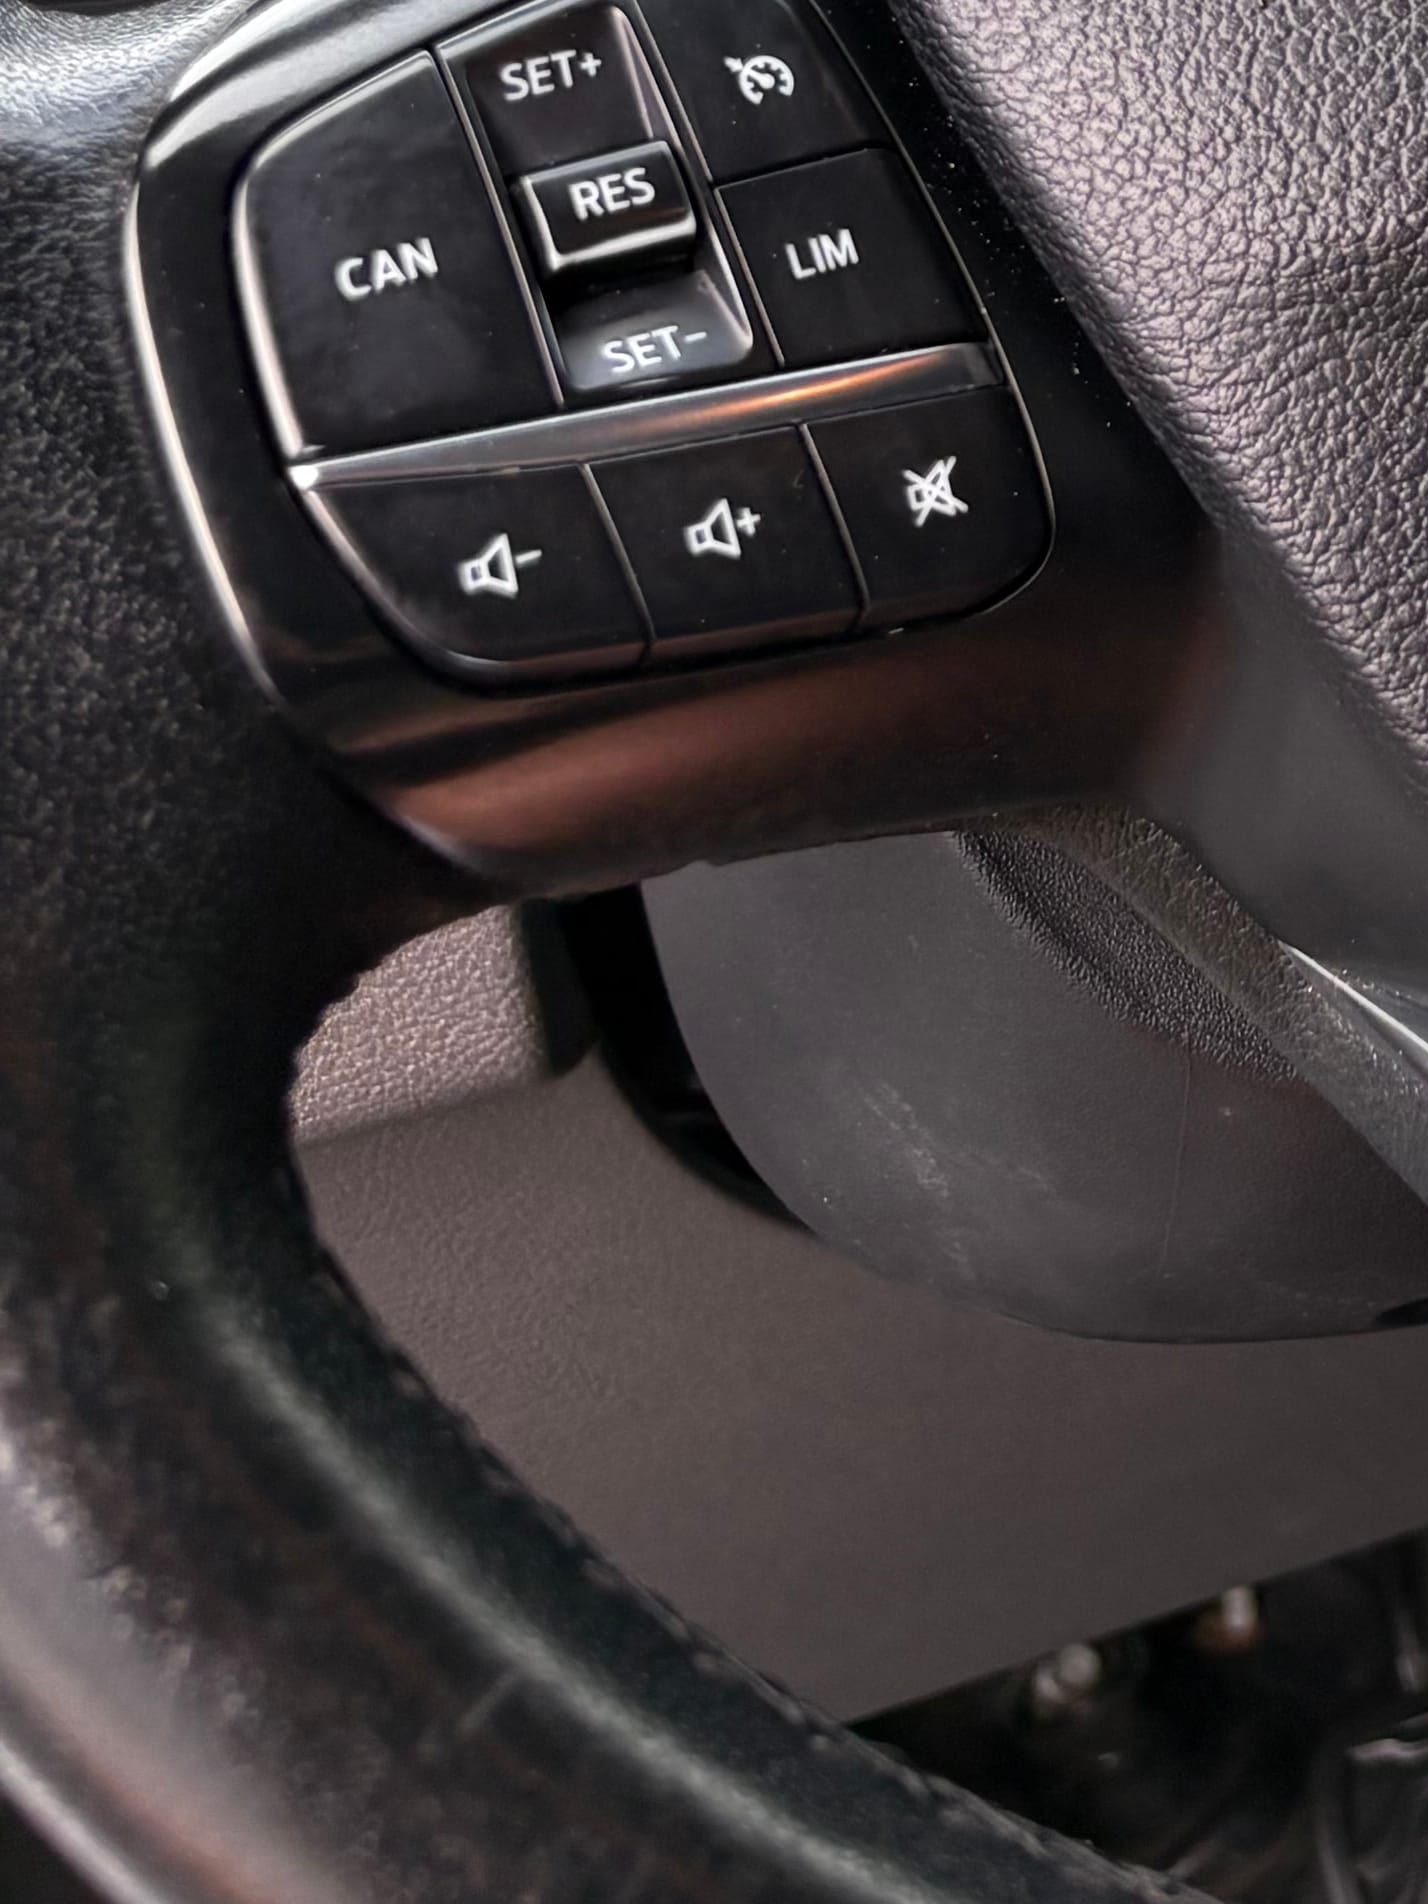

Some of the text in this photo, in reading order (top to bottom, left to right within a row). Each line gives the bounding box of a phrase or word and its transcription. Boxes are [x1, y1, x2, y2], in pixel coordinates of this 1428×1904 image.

[499, 49, 602, 102] SET+
[568, 166, 656, 222] RES
[333, 237, 439, 302] CAN
[787, 228, 860, 283] LIM
[601, 324, 708, 377] SET-
